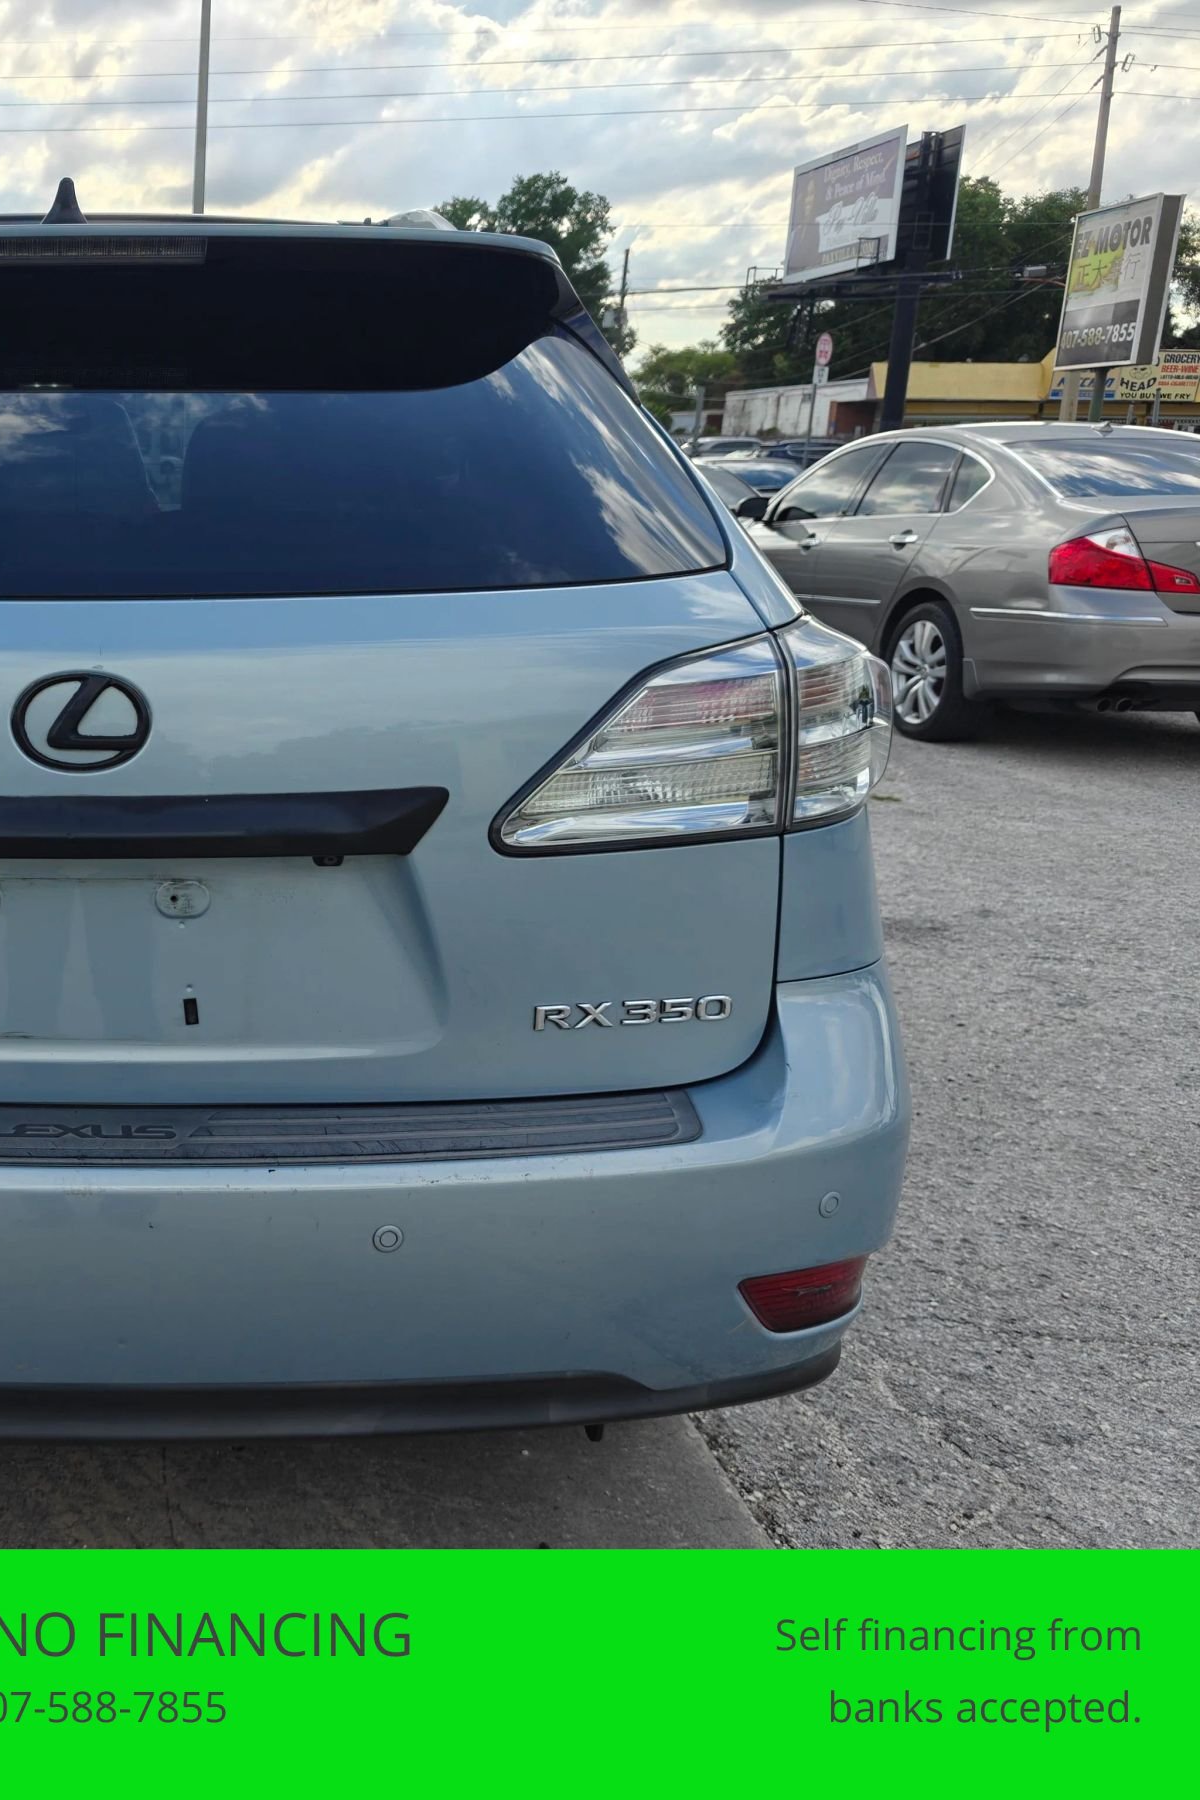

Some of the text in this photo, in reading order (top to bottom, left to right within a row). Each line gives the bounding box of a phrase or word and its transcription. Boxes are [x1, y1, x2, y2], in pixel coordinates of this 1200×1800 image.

[1095, 215, 1153, 256] MOTOR
[1060, 321, 1138, 350] 407-588-7855
[1120, 377, 1157, 392] HEAD
[1174, 392, 1191, 400] FRY
[533, 995, 733, 1032] RX 350
